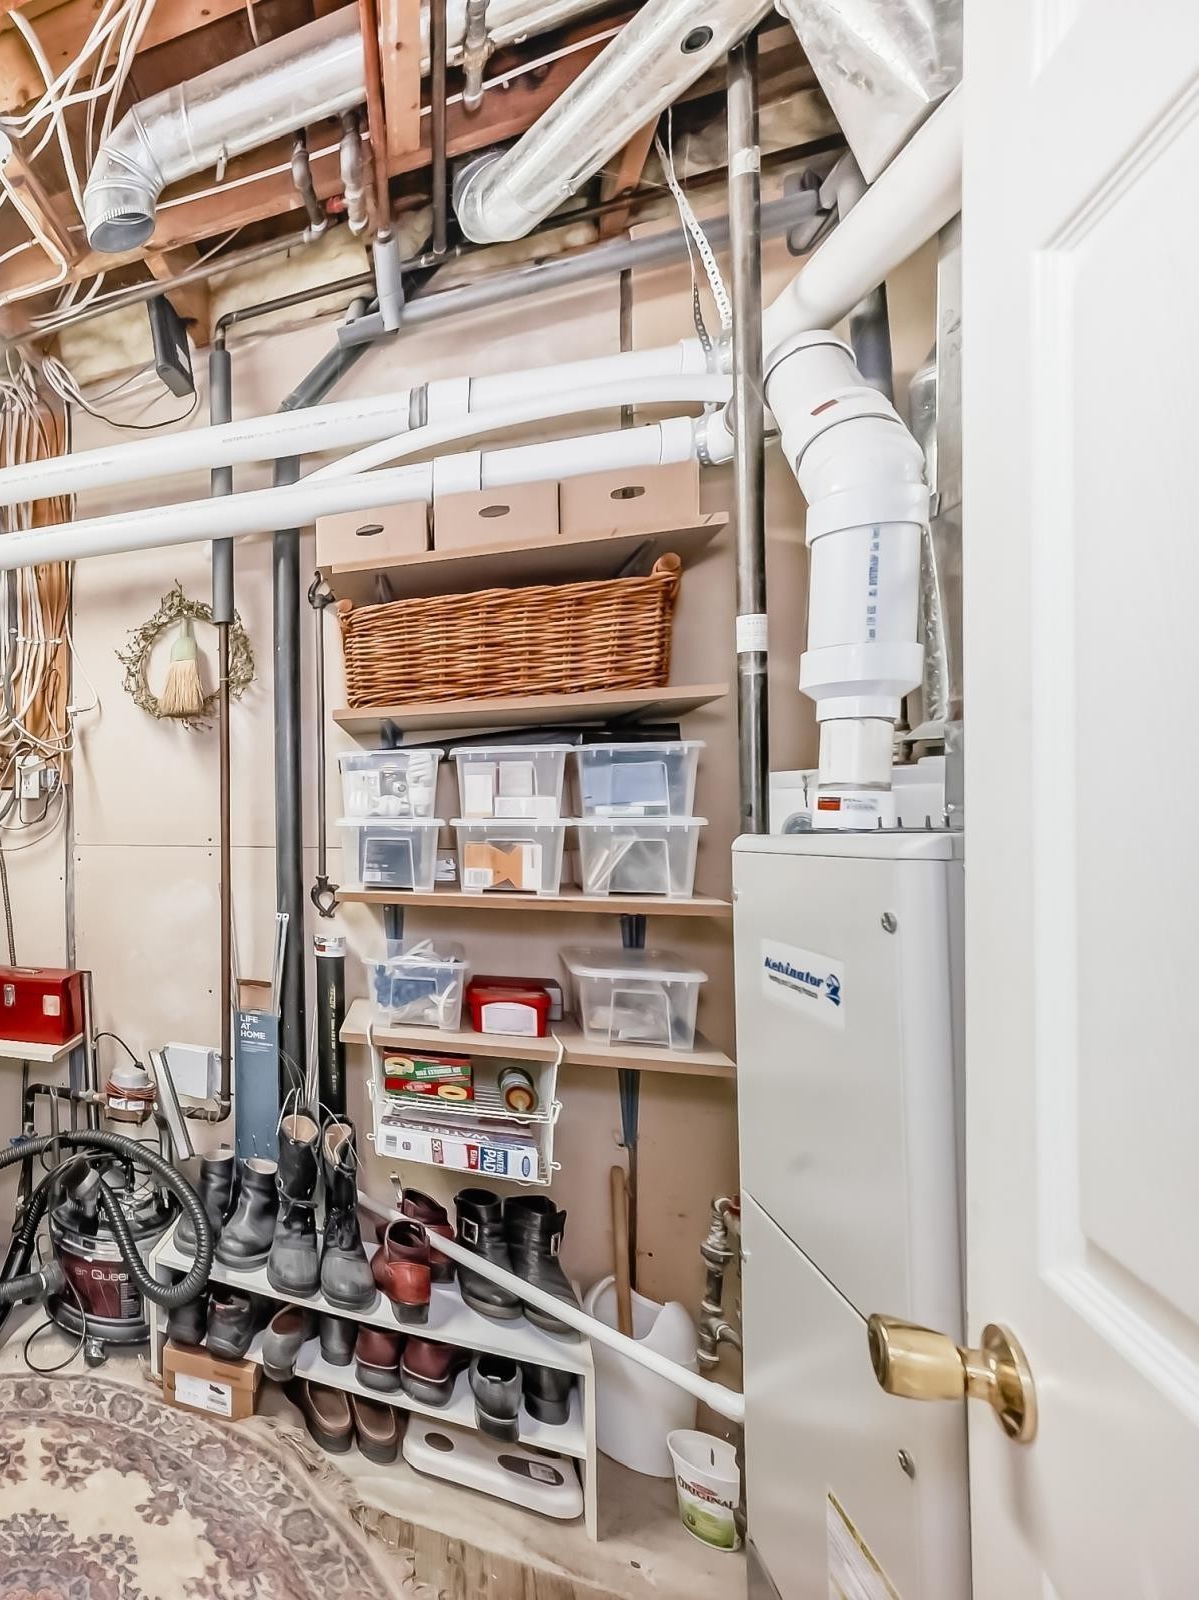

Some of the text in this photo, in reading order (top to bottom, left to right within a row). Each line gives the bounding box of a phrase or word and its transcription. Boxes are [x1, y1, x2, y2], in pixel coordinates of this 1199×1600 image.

[240, 1014, 259, 1024] LIFE
[240, 1022, 251, 1030] AT
[240, 1030, 266, 1040] HOME
[483, 1148, 496, 1173] PAD
[495, 1150, 504, 1174] WATER
[74, 1266, 88, 1276] er
